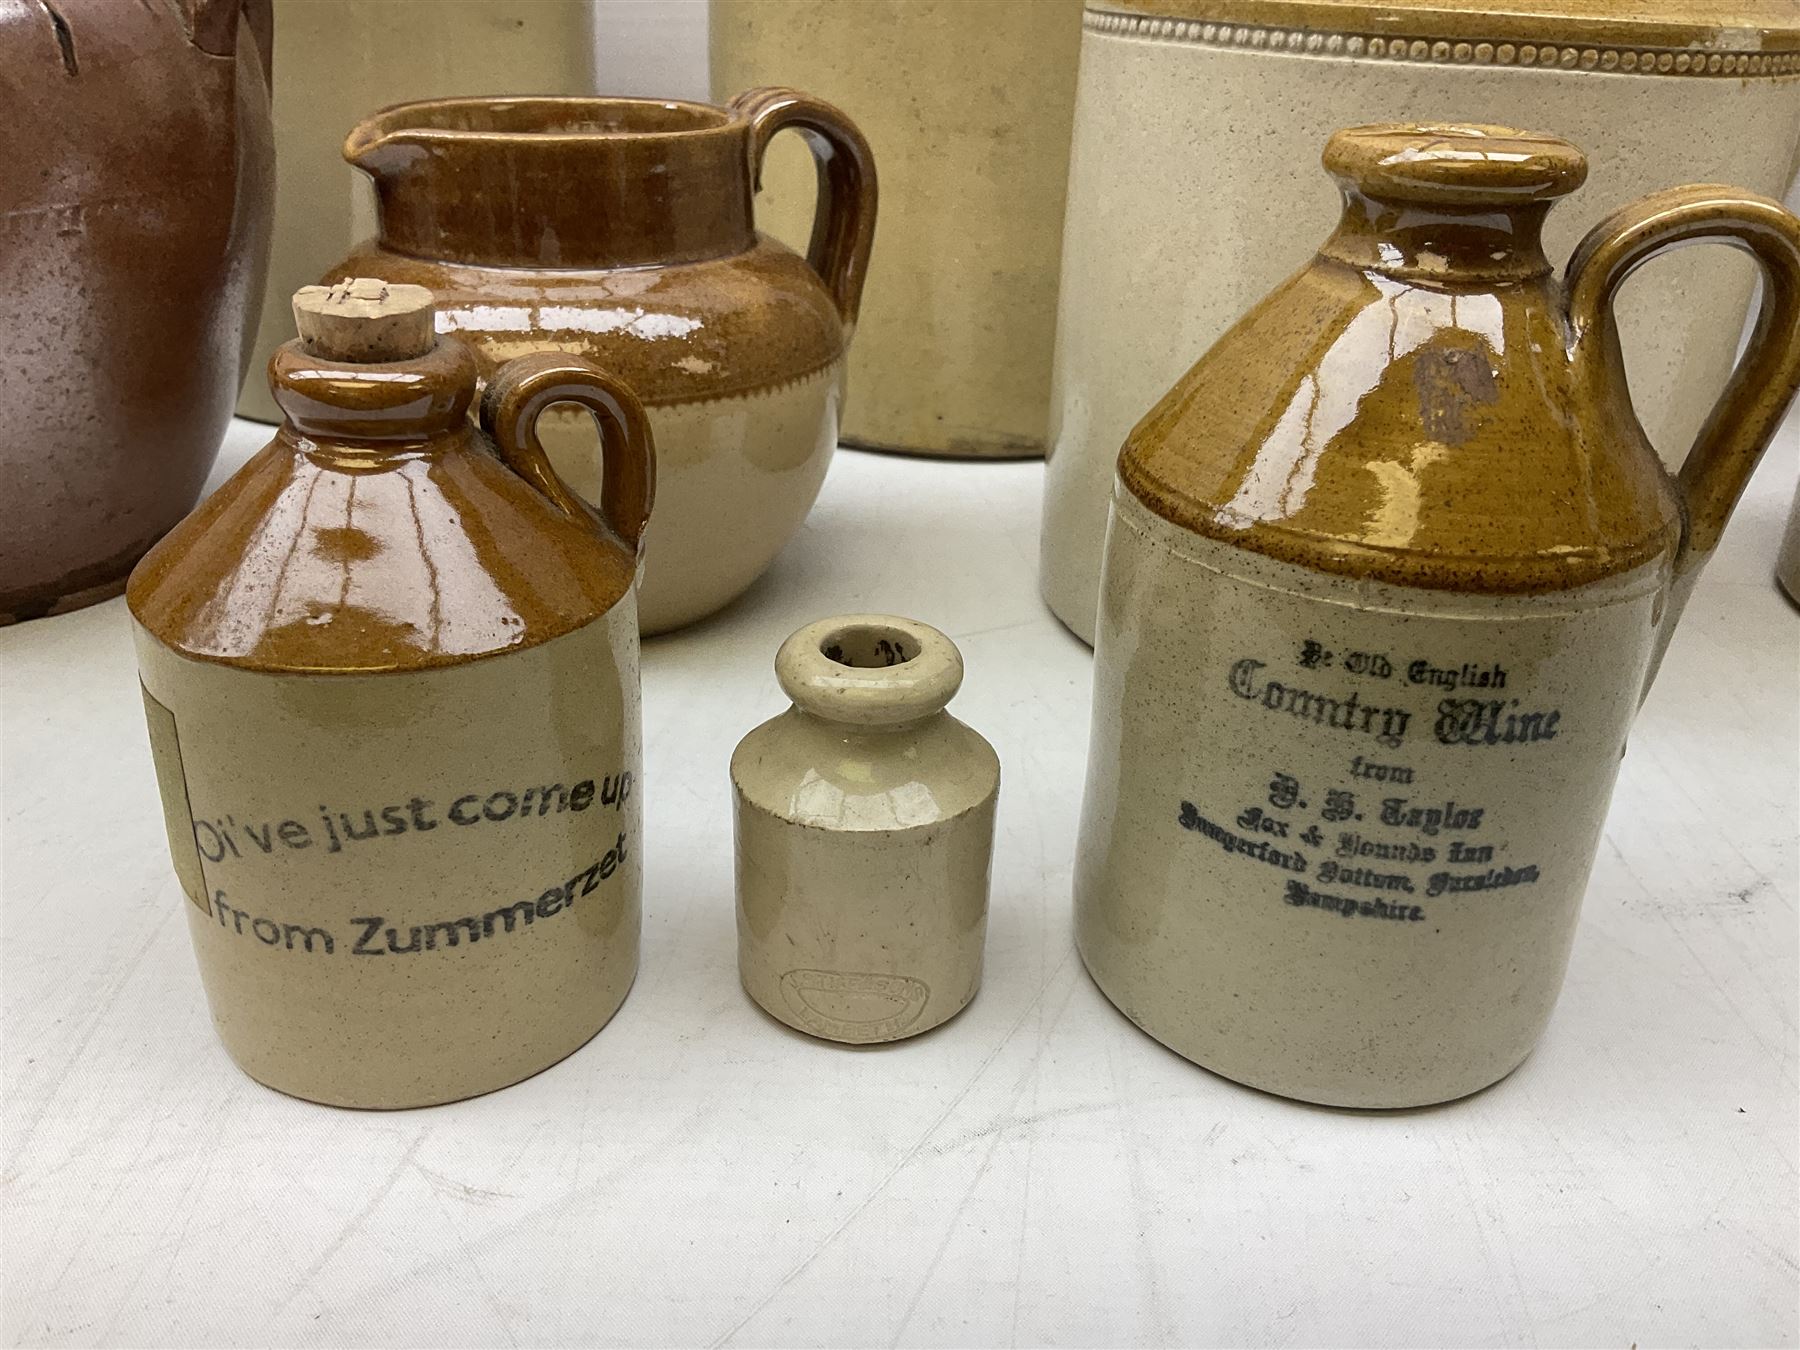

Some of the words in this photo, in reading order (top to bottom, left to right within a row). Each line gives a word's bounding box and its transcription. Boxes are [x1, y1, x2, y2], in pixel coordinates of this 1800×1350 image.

[1345, 651, 1392, 680] Old
[1411, 659, 1508, 691] English
[1229, 658, 1412, 747] Country
[1434, 698, 1562, 745] Wine
[1350, 755, 1415, 785] from
[193, 814, 314, 864] Oi've
[319, 796, 438, 853] just
[448, 779, 595, 826] come
[602, 769, 633, 811] up
[1237, 807, 1290, 839] Fox
[1300, 825, 1324, 848] &
[1336, 832, 1437, 862] Hounds
[1448, 841, 1494, 864] Inn
[1380, 797, 1485, 836] Taylor
[214, 890, 335, 955] from
[351, 832, 628, 956] Zummerzet
